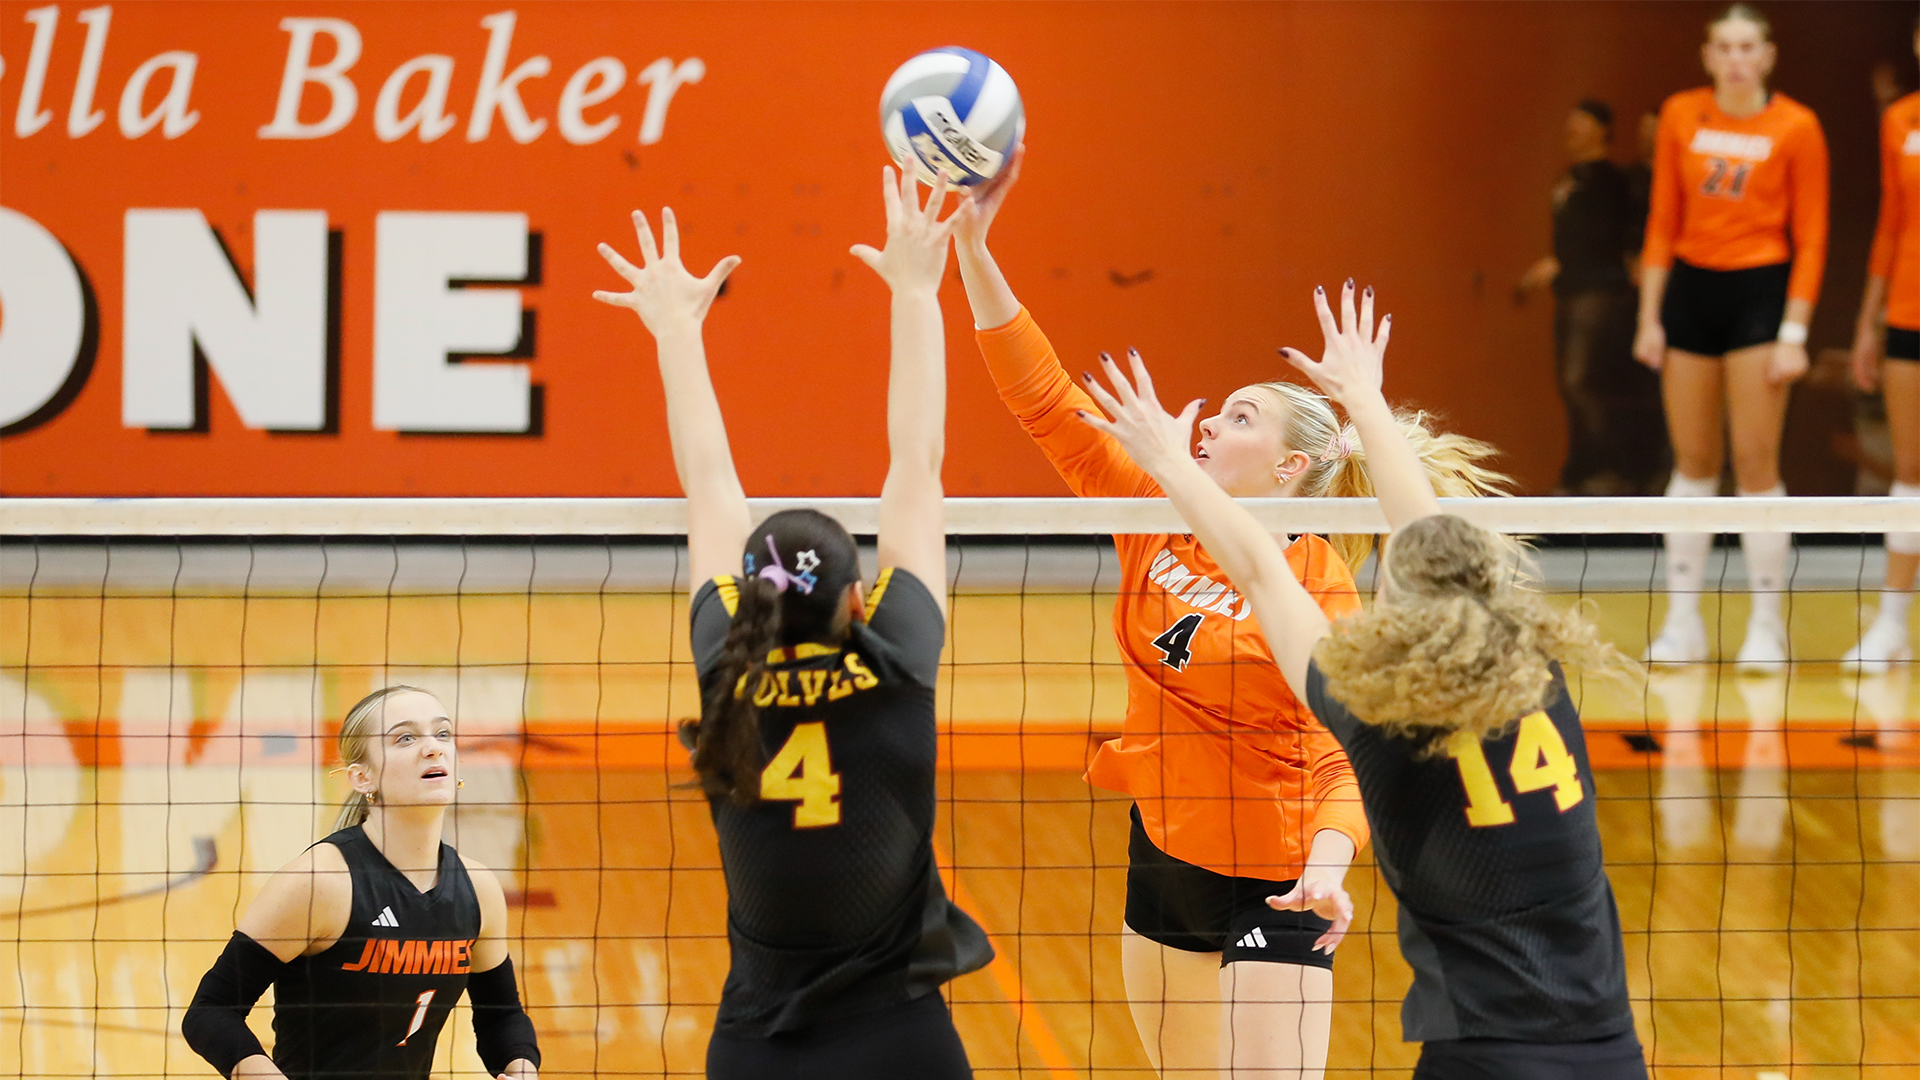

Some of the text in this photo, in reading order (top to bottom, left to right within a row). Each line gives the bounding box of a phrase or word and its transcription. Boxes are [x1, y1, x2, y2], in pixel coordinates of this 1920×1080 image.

[0, 4, 705, 145] lla Baker
[1700, 157, 1754, 202] 21
[1150, 612, 1206, 673] 4
[733, 652, 880, 708] OLVES
[760, 721, 843, 830] 4
[1445, 709, 1585, 829] 14
[395, 988, 437, 1047] 1
